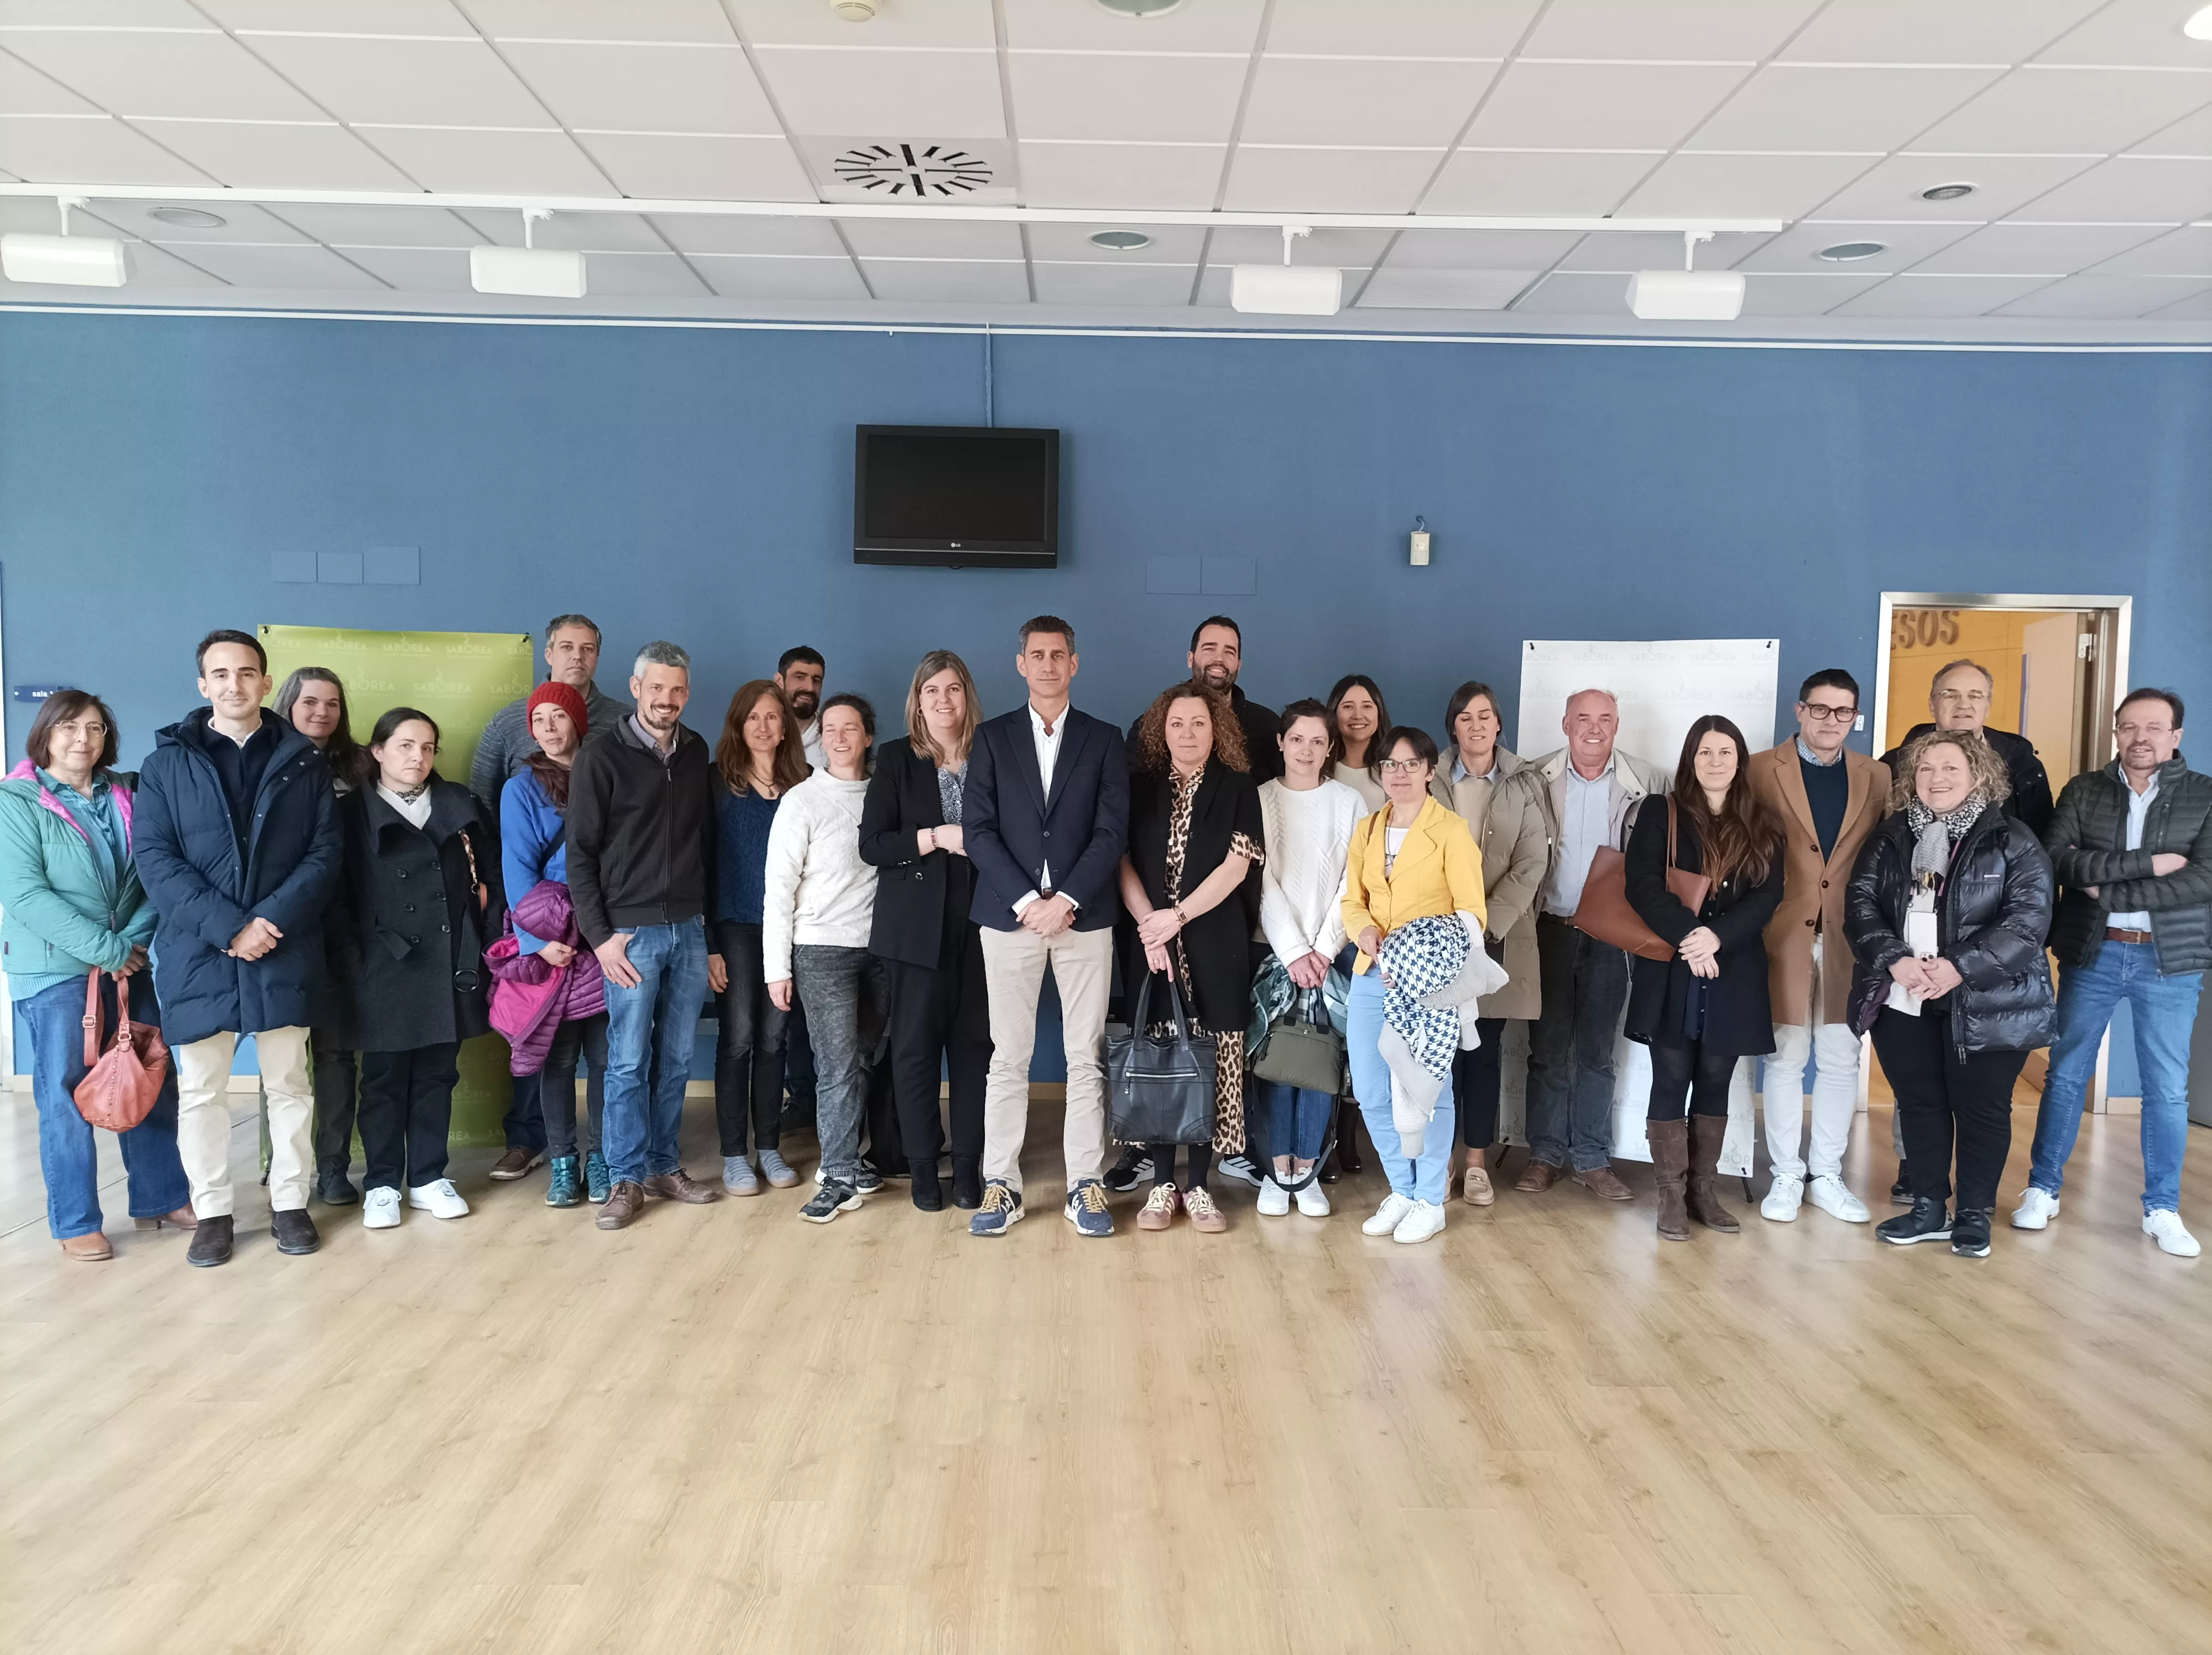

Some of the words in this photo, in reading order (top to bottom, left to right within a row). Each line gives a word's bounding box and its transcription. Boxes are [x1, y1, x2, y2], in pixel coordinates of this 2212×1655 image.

[382, 643, 431, 653] SABOREA
[446, 644, 493, 655] SABOREA
[413, 682, 472, 693] SABOREA
